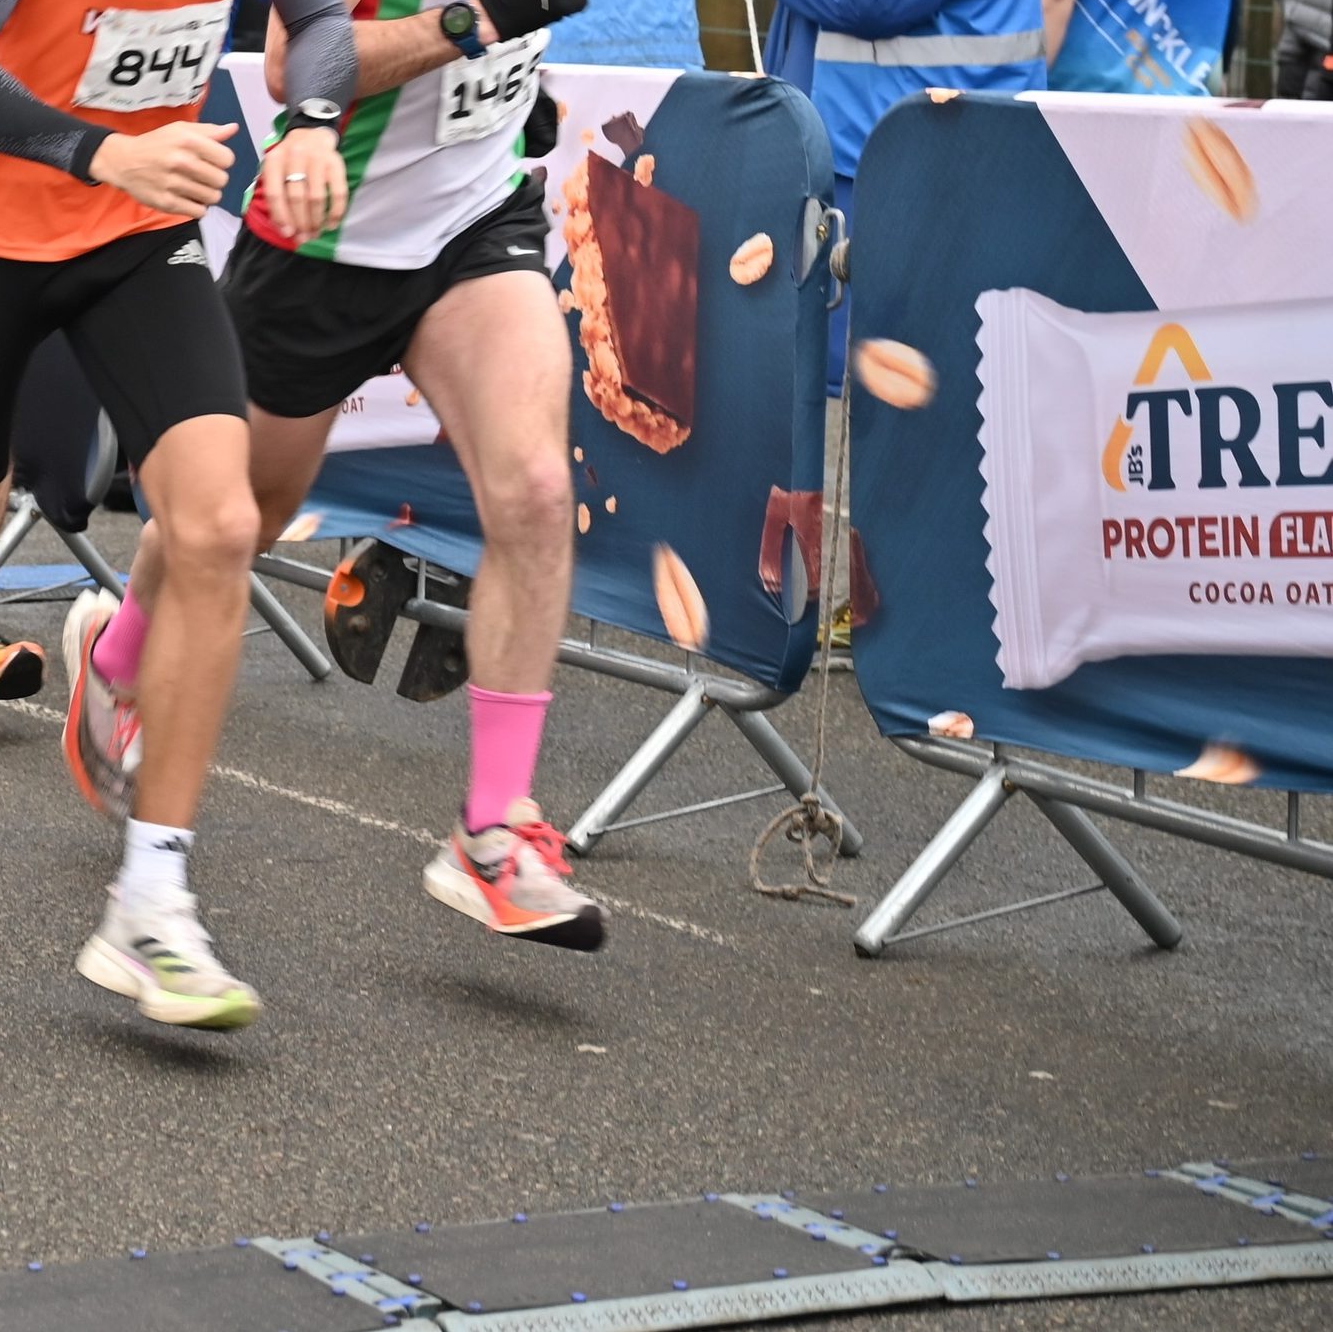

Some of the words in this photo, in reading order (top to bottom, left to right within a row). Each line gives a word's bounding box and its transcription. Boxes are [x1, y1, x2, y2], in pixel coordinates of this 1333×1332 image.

[110, 41, 211, 86] 844
[342, 397, 364, 414] OAT
[1128, 444, 1143, 486] JB's
[1102, 515, 1260, 558] PROTEIN
[1280, 516, 1333, 554] FLA
[1189, 582, 1274, 604] COCOA
[1286, 582, 1333, 604] OAT
